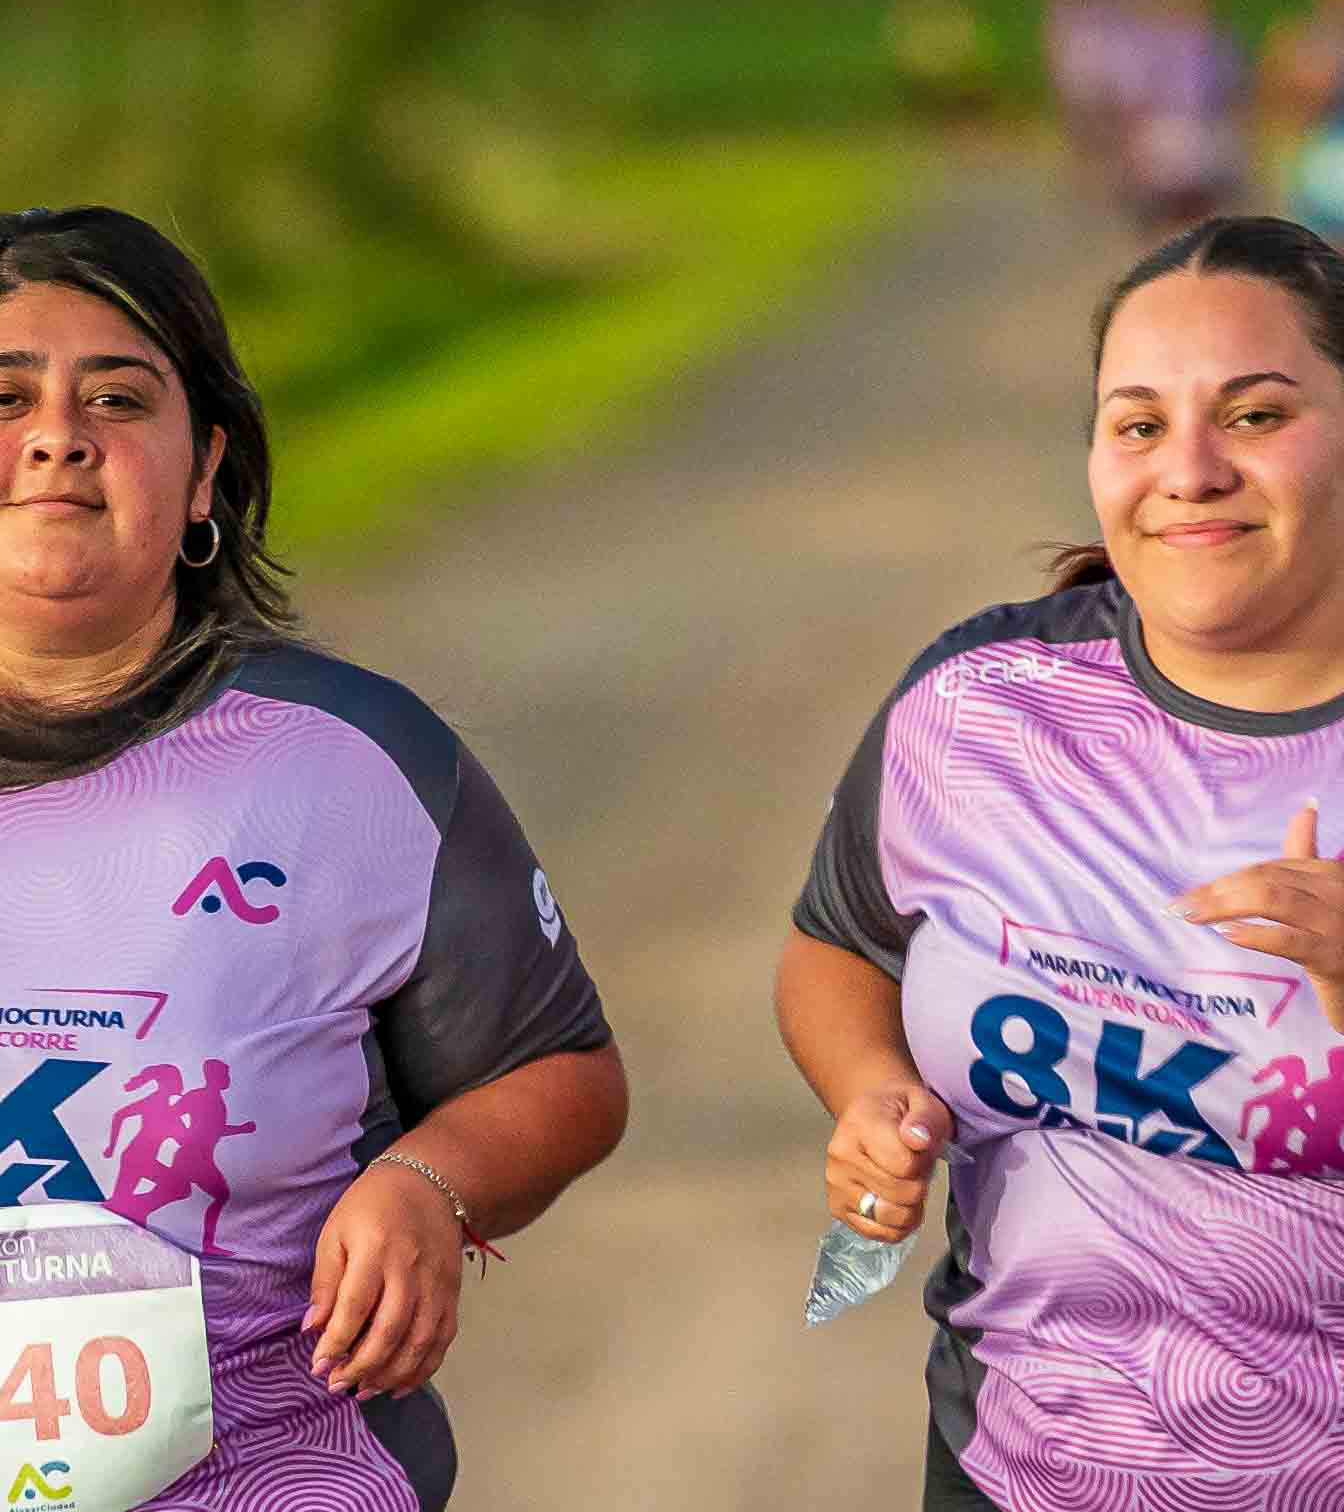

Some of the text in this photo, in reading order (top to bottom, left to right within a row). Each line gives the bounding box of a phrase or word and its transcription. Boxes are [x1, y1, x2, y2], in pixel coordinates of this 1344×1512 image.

[171, 856, 287, 925] AC
[1027, 948, 1257, 1018] MARATON NOCTURNA
[969, 994, 1246, 1171] 8K
[8, 1460, 72, 1503] AC
